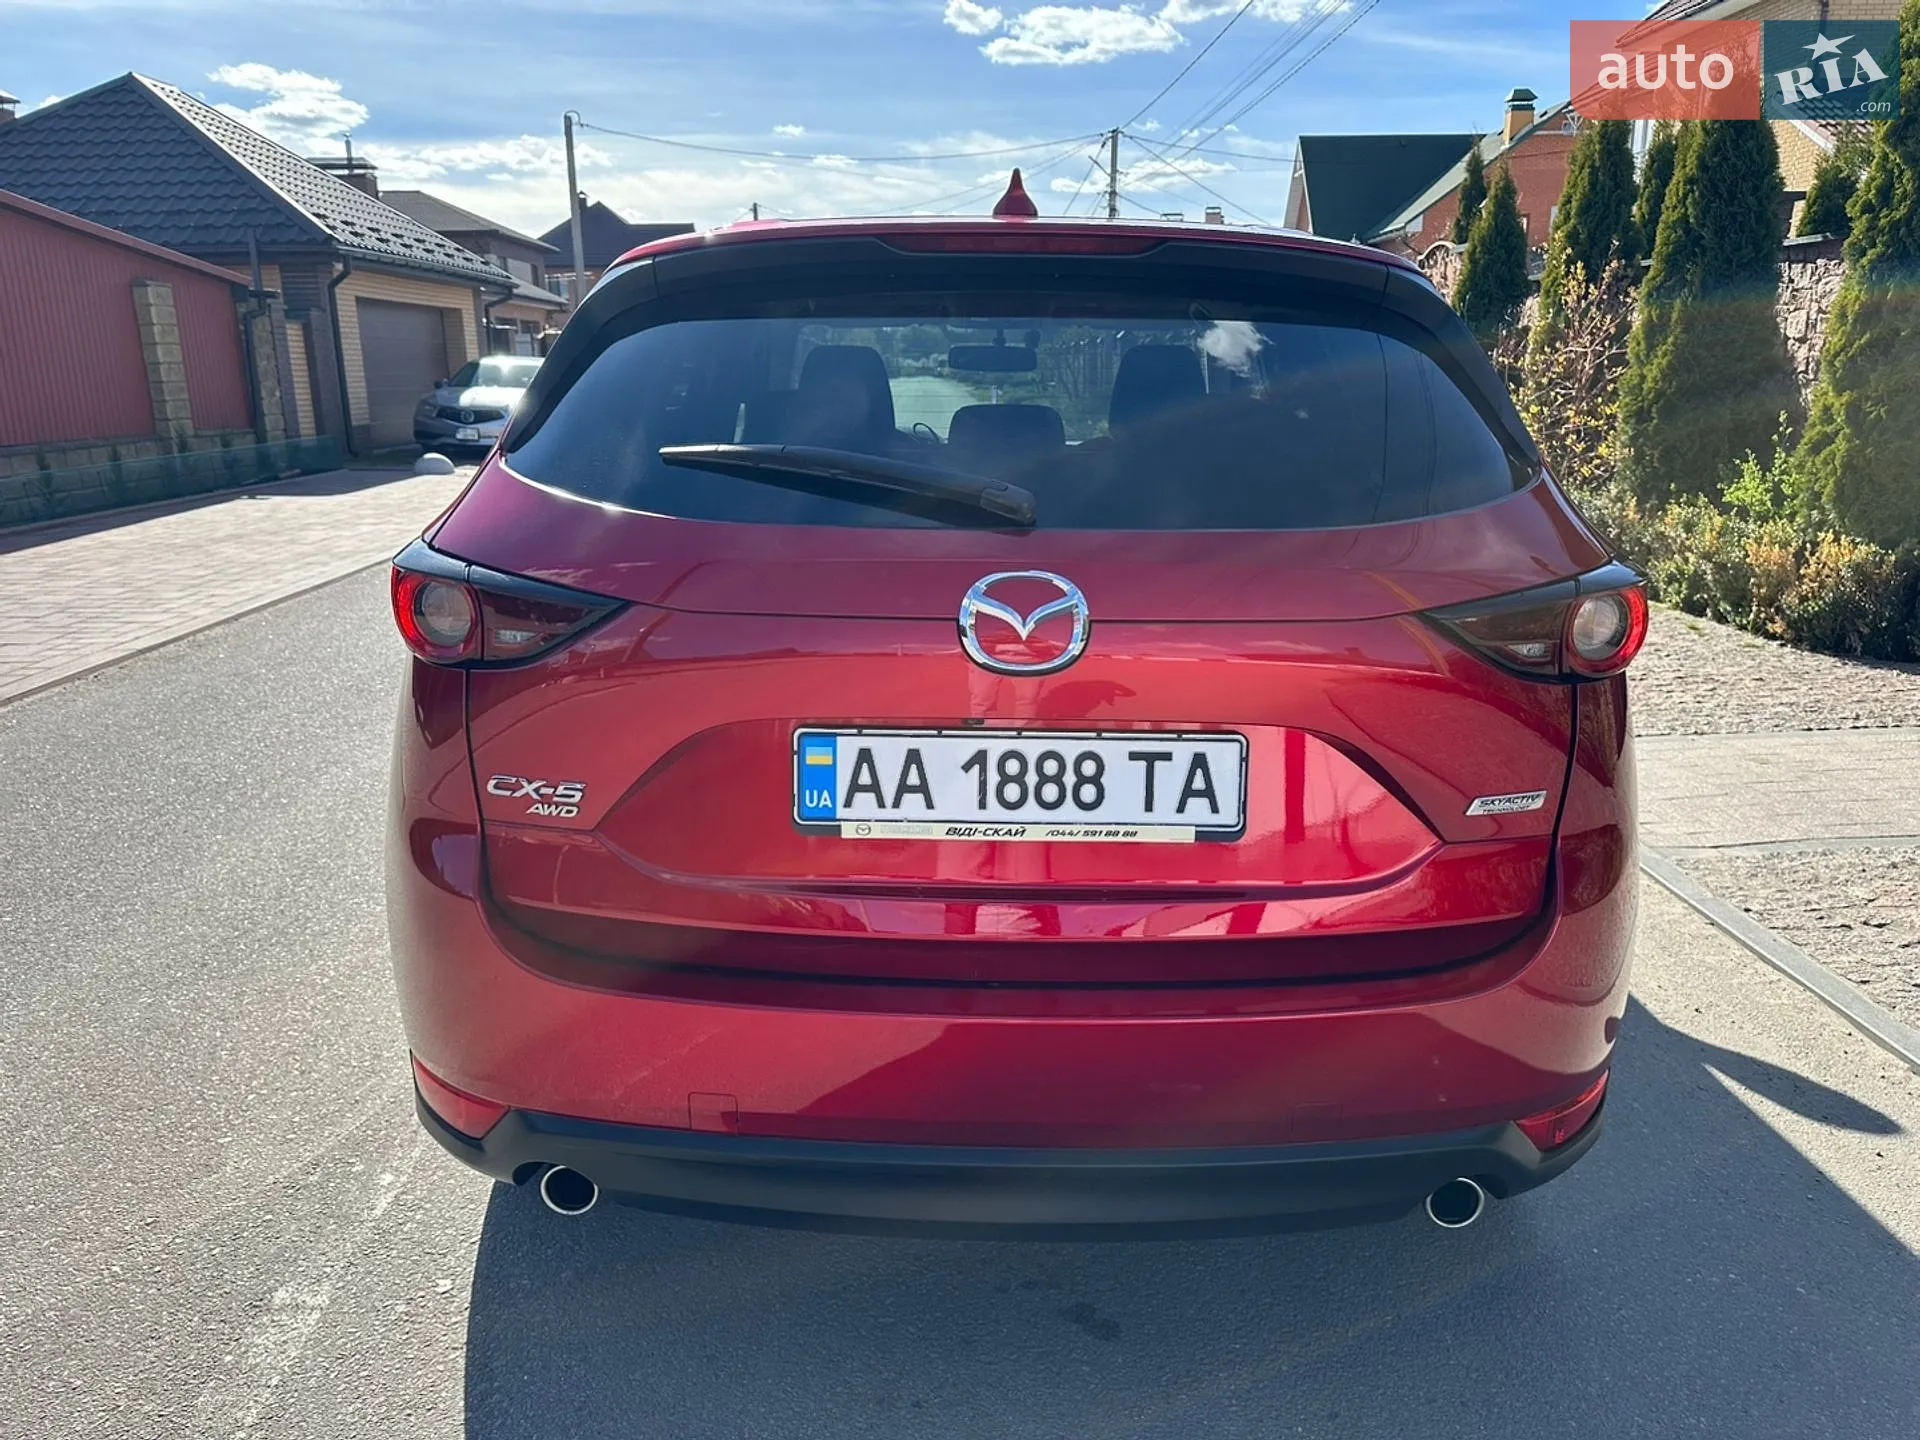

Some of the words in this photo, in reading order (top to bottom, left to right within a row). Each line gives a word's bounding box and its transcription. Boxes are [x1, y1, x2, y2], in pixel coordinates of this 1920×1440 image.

[486, 774, 586, 803] CX-5
[843, 747, 935, 809] AA
[961, 749, 1105, 811] 1888
[1128, 751, 1219, 814] TA
[526, 803, 579, 818] AWD
[805, 789, 833, 808] UA
